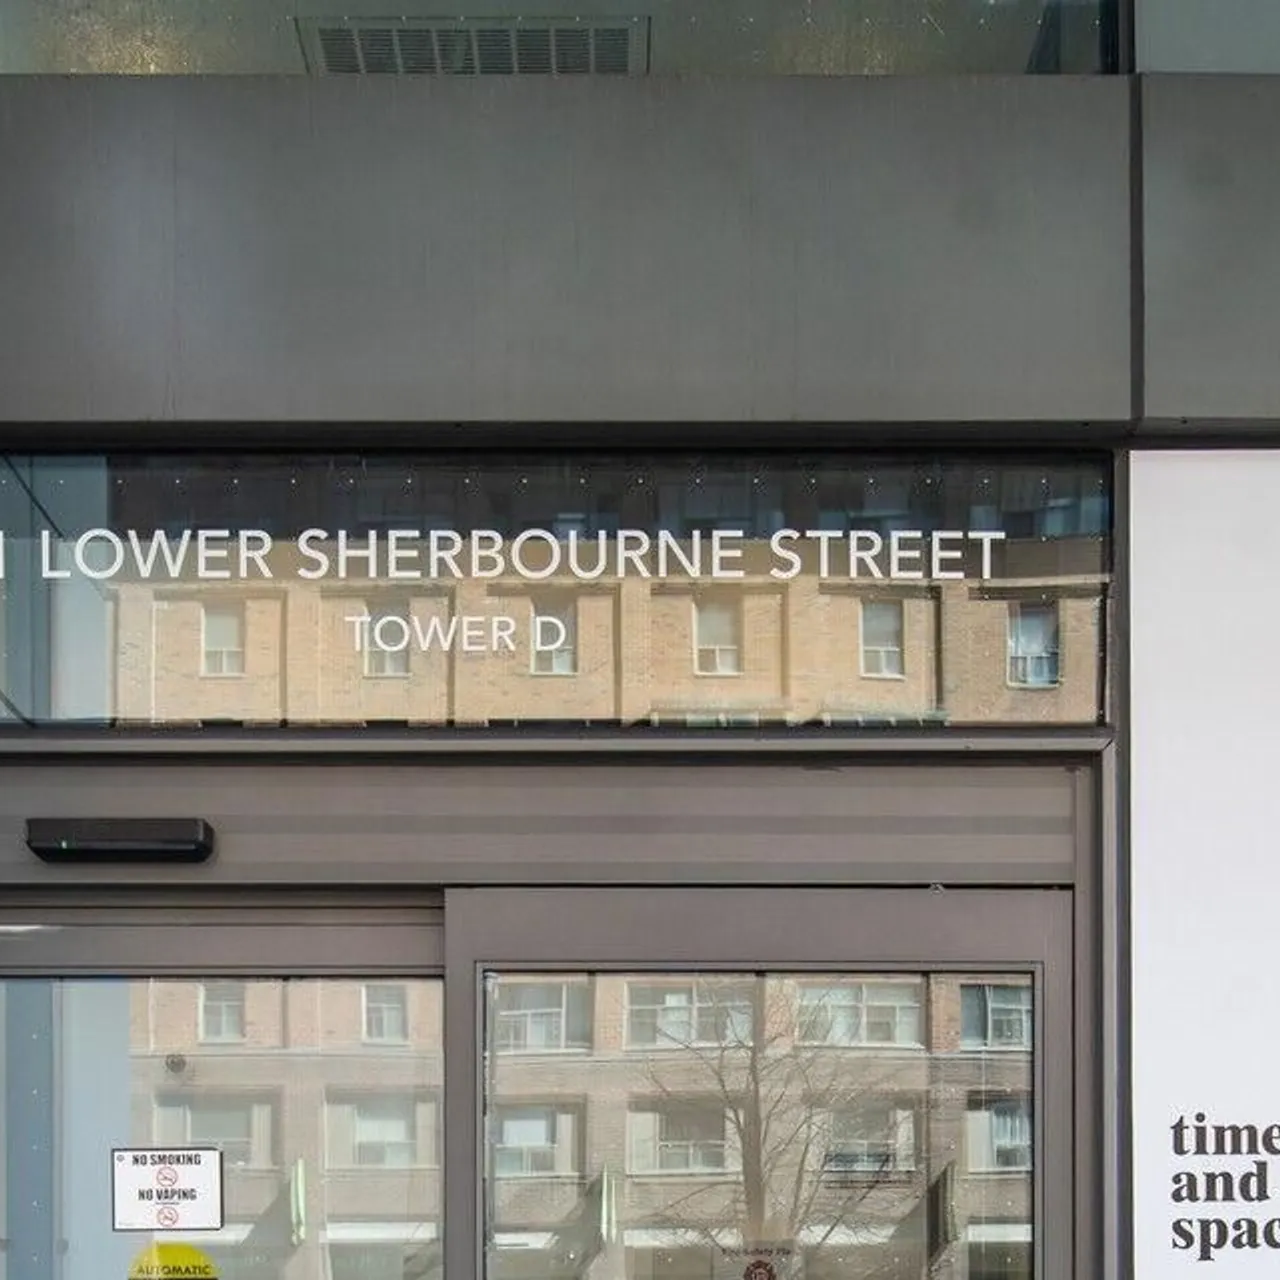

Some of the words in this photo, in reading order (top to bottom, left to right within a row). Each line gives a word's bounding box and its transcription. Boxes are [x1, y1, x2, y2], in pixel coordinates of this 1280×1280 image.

[41, 530, 272, 580] LOWER
[297, 530, 745, 580] SHERBOURNE
[770, 530, 1006, 580] STREET
[344, 615, 517, 653] TOWER
[534, 615, 565, 653] D
[132, 1154, 147, 1165] NO
[150, 1154, 201, 1166] SMOKING
[1171, 1160, 1270, 1203] and
[138, 1189, 153, 1200] NO
[156, 1189, 197, 1200] VAPING
[138, 1265, 210, 1274] AUTOMATIC
